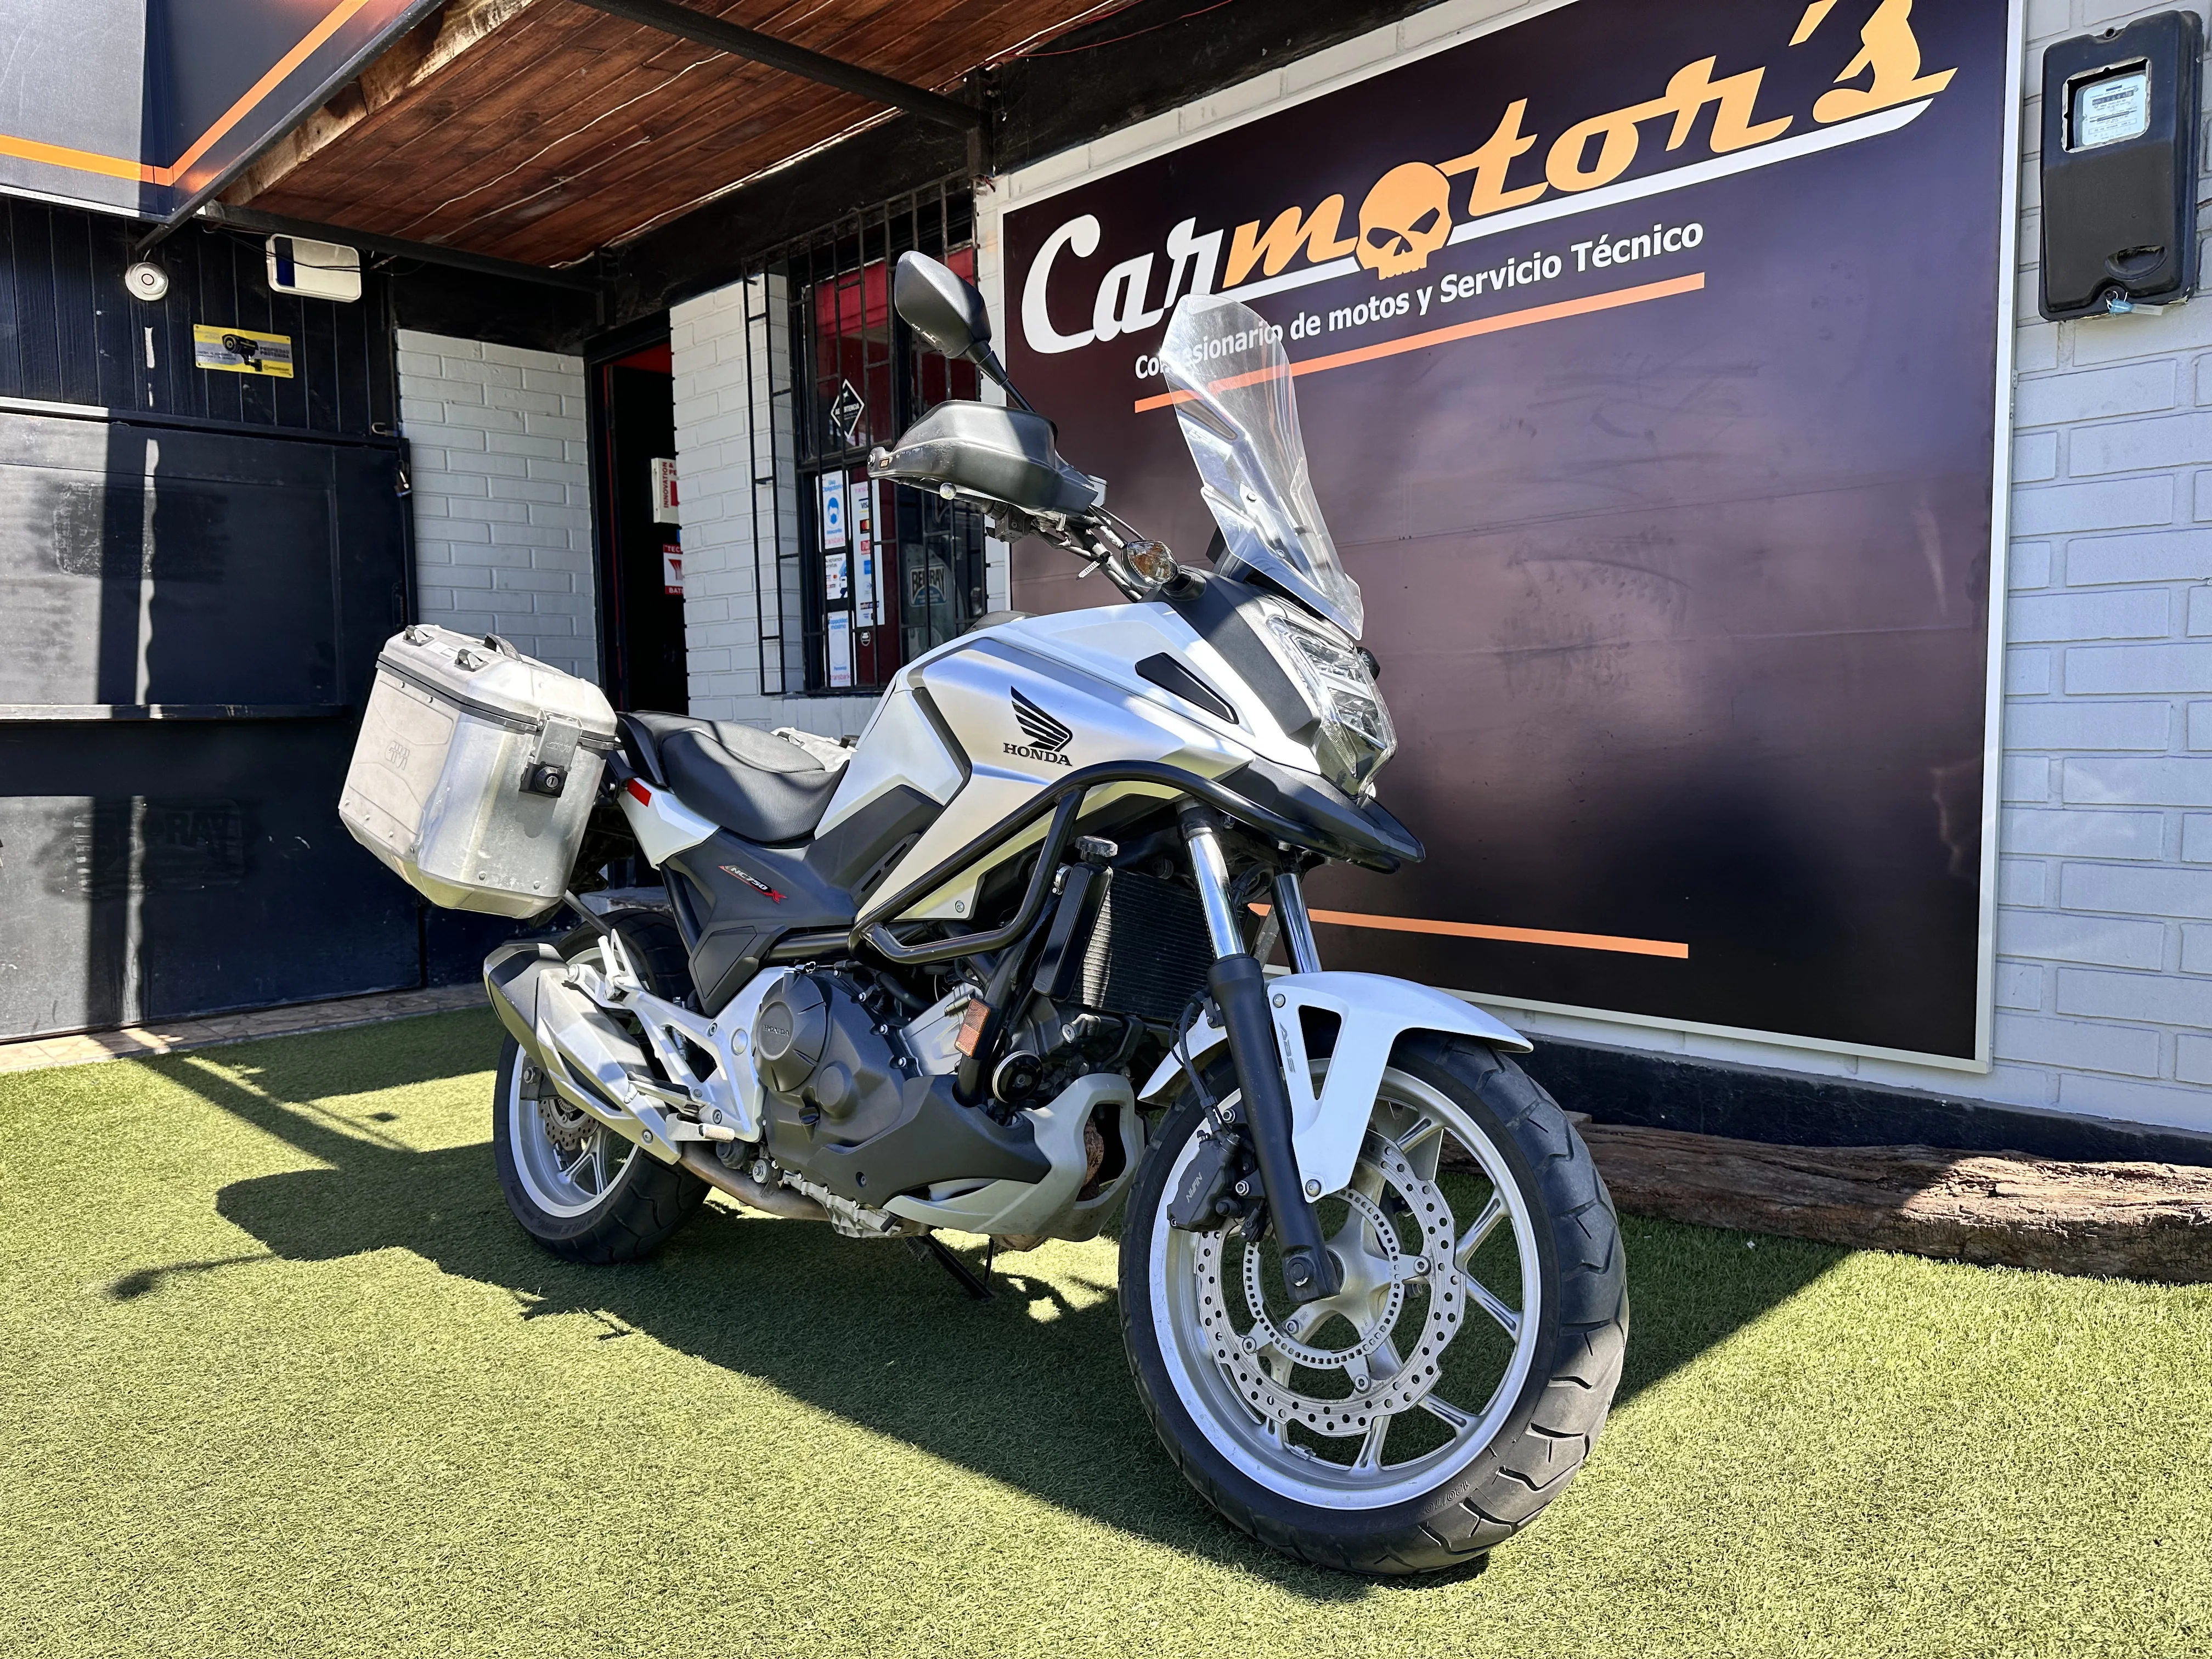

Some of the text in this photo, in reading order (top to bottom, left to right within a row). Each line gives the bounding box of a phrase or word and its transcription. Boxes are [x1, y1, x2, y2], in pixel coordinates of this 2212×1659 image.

[1290, 311, 1321, 341] de
[1329, 293, 1409, 332] motos
[1417, 288, 1433, 317] y
[1440, 250, 1562, 303] Servicio
[1571, 222, 1704, 272] Técnico
[1003, 742, 1073, 767] HONDA
[763, 1024, 790, 1037] HONDA
[1279, 1022, 1296, 1073] ABS
